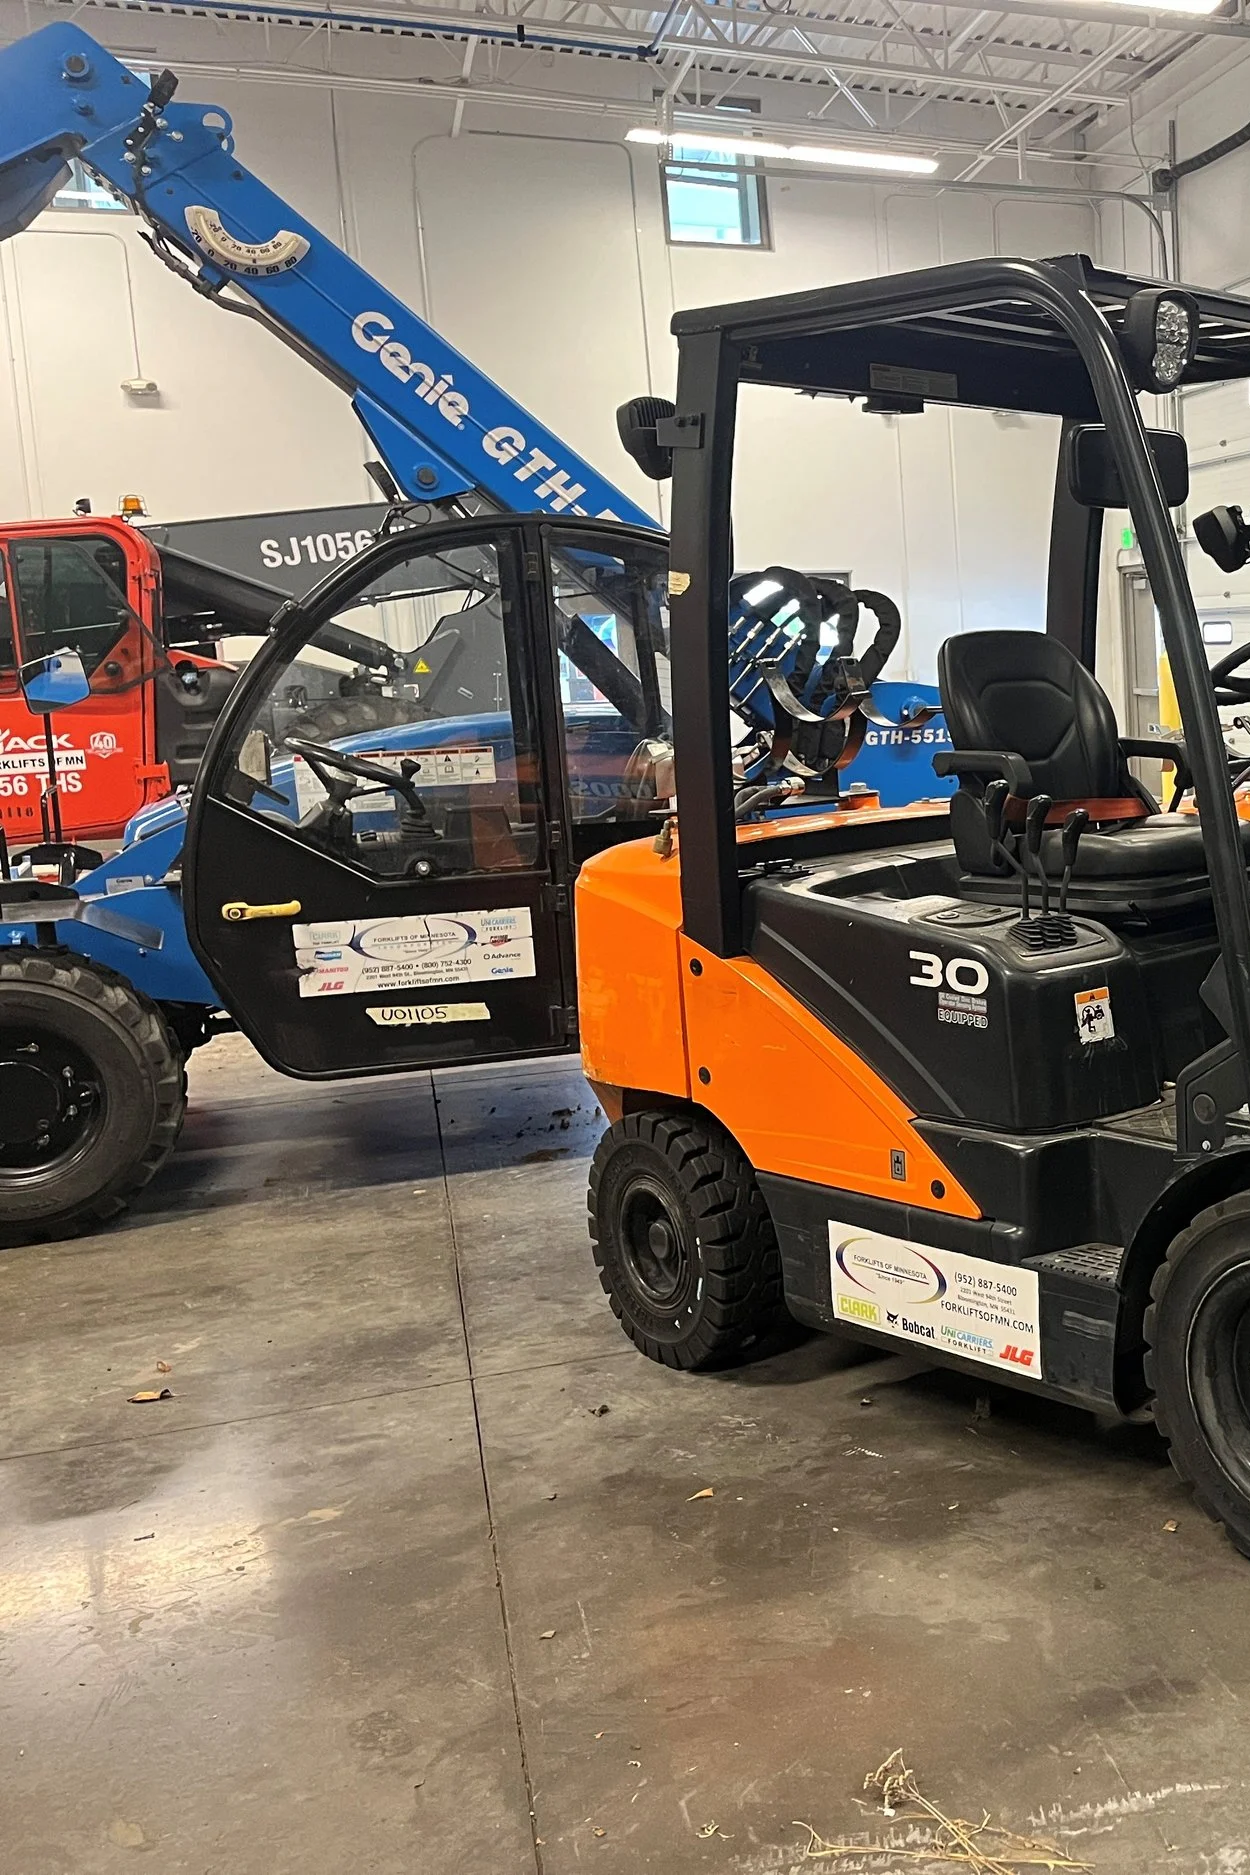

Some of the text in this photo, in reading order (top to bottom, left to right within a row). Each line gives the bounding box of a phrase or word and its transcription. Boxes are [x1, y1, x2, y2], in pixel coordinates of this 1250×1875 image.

[207, 248, 215, 258] 0
[244, 266, 259, 275] 40
[266, 265, 280, 274] 60
[284, 256, 298, 268] 80
[352, 311, 469, 427] Genie
[260, 529, 374, 568] SJ1056
[94, 735, 113, 749] 40
[65, 756, 84, 765] MN
[374, 935, 408, 943] FORKLIFTS
[361, 967, 380, 975] (952)
[381, 963, 414, 972] 887-5400
[441, 959, 472, 967] 752-4300
[909, 950, 989, 995] 30
[318, 981, 344, 991] JLG
[377, 976, 460, 988] www.forkliftsofmn.com
[938, 1008, 988, 1029] EQUIPPED
[853, 1254, 883, 1268] FORKLIFTS
[894, 1265, 927, 1280] MINNESOTA
[954, 1272, 1017, 1297] (952) 887-5400
[840, 1296, 878, 1321] CLARK
[941, 1300, 1034, 1334] FORKLIFTSOFMN.COM
[902, 1317, 935, 1339] Bobcat
[948, 1338, 986, 1354] FORKLIFT
[999, 1344, 1034, 1366] JLG
